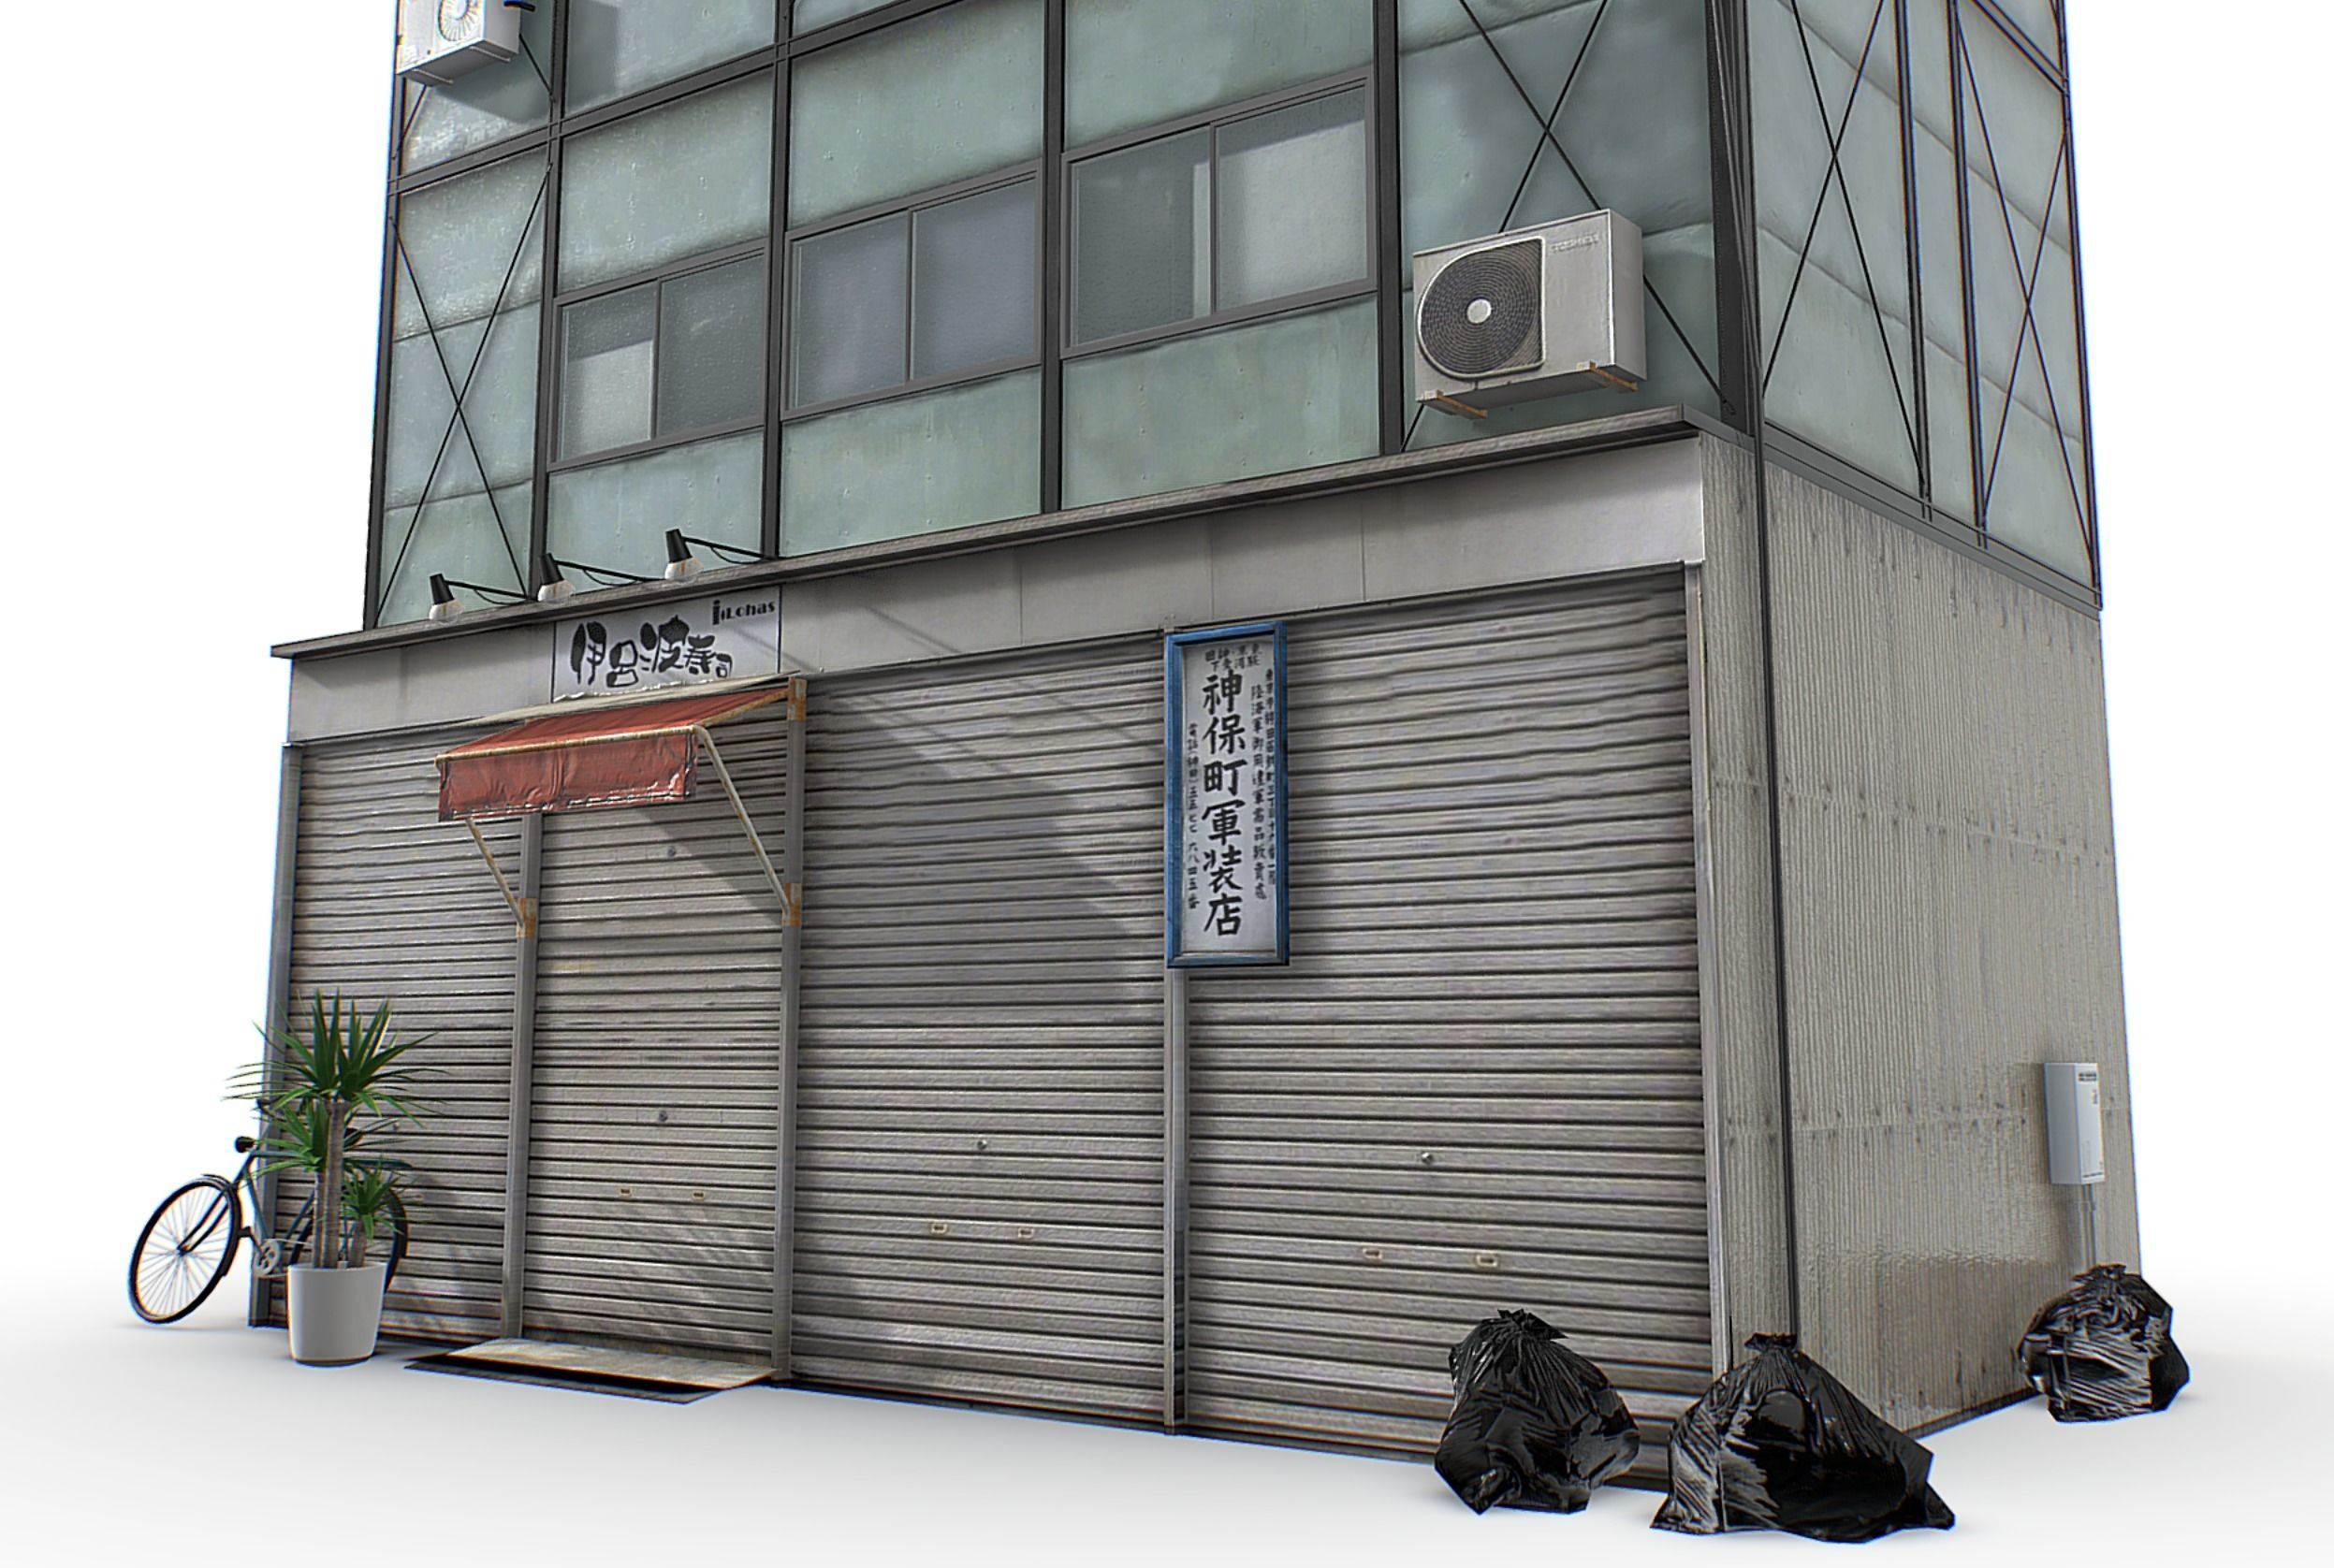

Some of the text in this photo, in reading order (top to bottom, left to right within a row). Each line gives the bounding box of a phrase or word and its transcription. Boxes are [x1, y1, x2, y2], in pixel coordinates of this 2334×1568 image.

[570, 614, 733, 688] 伊呂波寿司
[1202, 669, 1248, 936] 神保町軍装店
